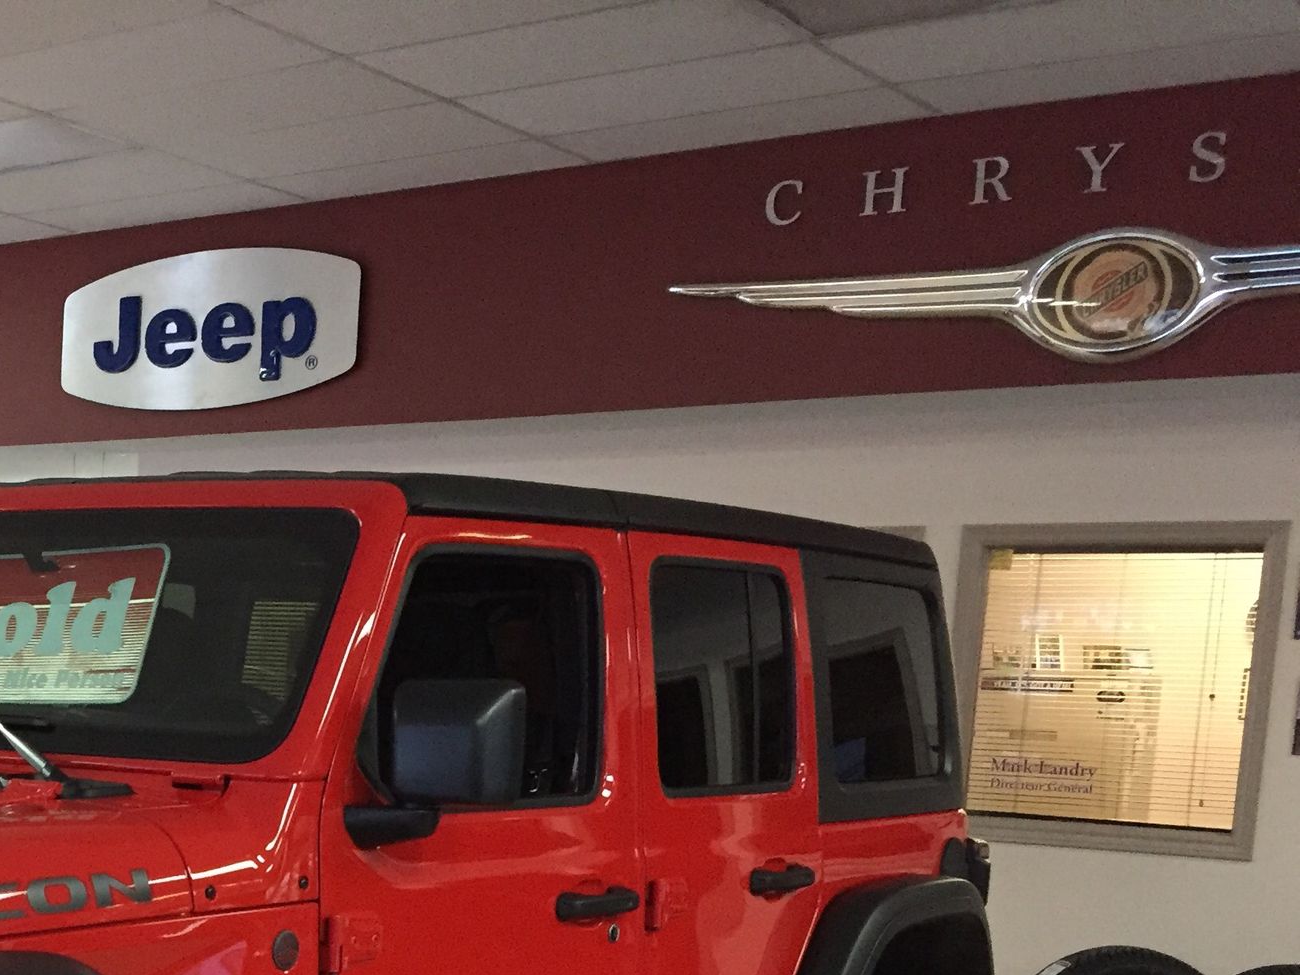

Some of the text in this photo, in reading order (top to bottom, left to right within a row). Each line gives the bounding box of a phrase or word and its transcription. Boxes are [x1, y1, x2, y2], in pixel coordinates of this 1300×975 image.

[764, 130, 1228, 227] CHRYS
[93, 295, 318, 382] Jeep
[4, 667, 48, 689] Nice
[990, 757, 1097, 782] Mark Landry
